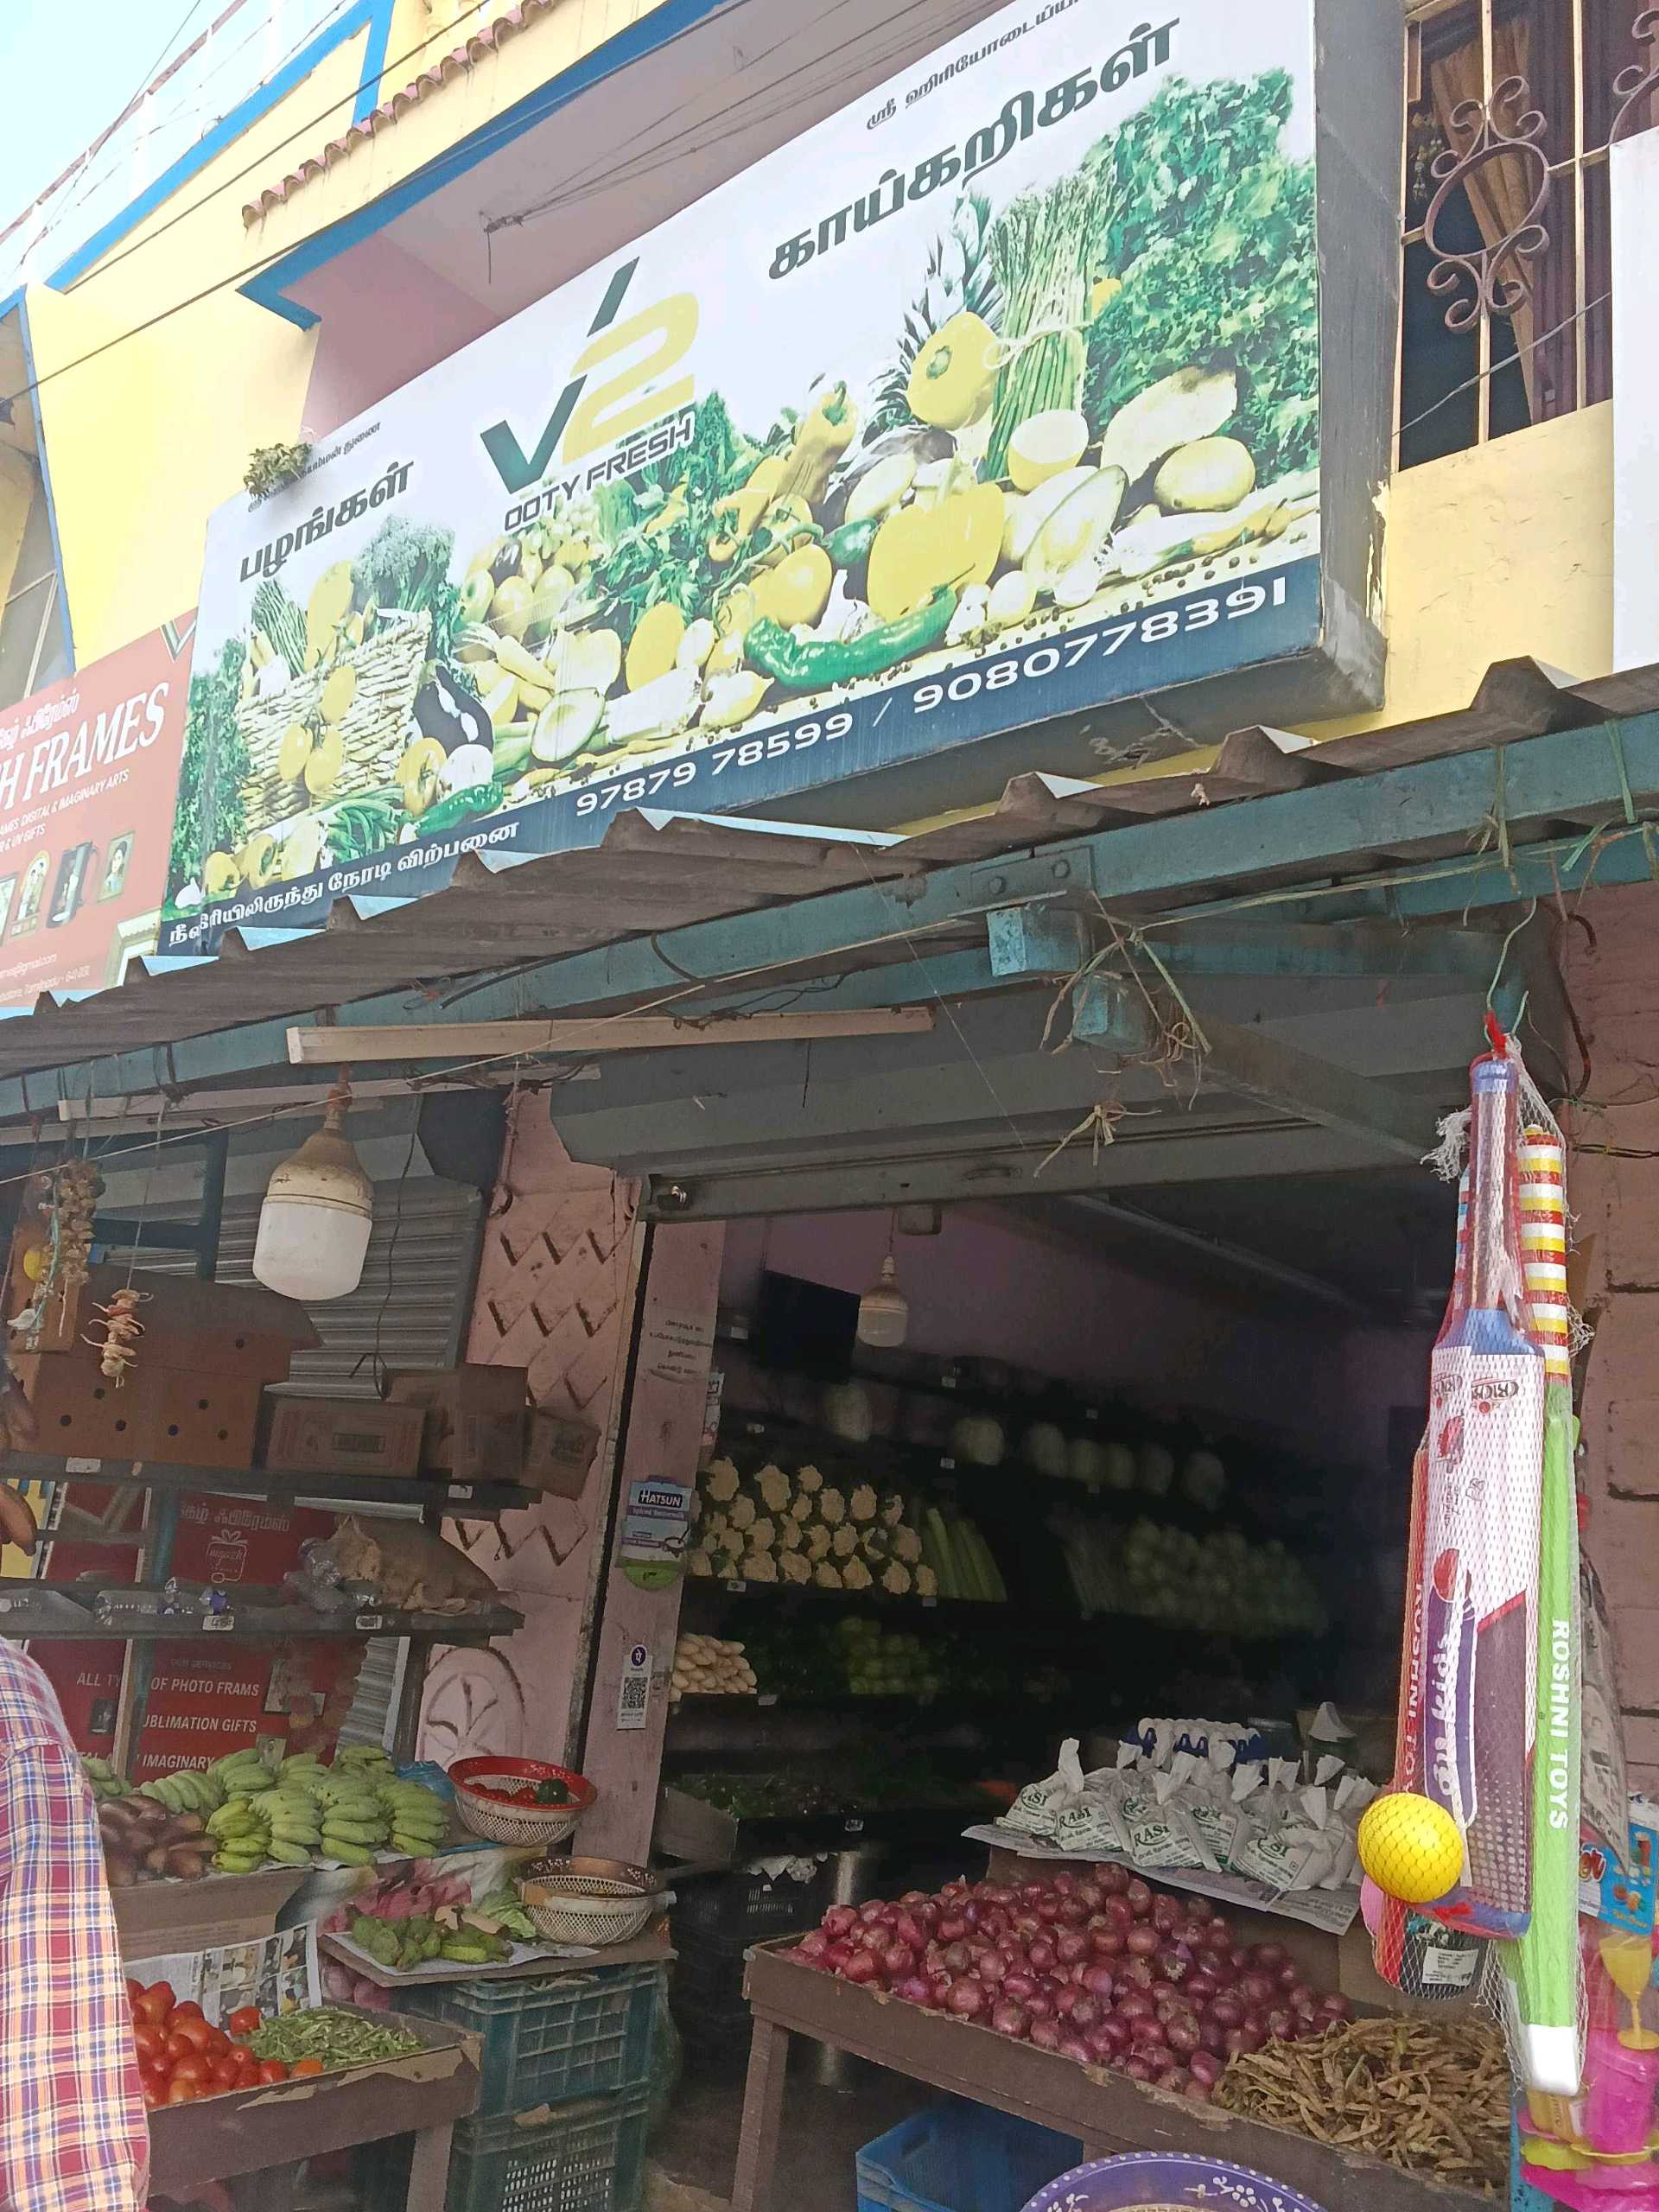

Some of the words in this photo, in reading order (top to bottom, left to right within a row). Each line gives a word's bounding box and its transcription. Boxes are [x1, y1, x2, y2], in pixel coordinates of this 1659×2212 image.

[768, 18, 1179, 280] காய்கறிகள்
[505, 474, 581, 532] OOTY
[586, 419, 696, 490] FRESH
[239, 461, 414, 582] பழங்கள்
[575, 763, 696, 817] 97879
[712, 712, 855, 776] 78599
[912, 576, 1288, 713] 9080778391
[22, 682, 169, 802] FRAMES
[107, 768, 130, 788] ARTS
[327, 861, 392, 893] நேரடி
[397, 822, 519, 872] விற்பனை
[640, 1488, 681, 1507] HATSUN
[76, 1672, 101, 1687] ALL
[150, 1676, 168, 1691] OF
[171, 1677, 214, 1694] PHOTO
[216, 1681, 260, 1697] FRAMS
[1550, 1619, 1570, 1738] ROSHNI
[221, 1717, 257, 1734] GIFTS
[1549, 1751, 1569, 1830] TOYS
[1134, 1824, 1171, 1847] RASI
